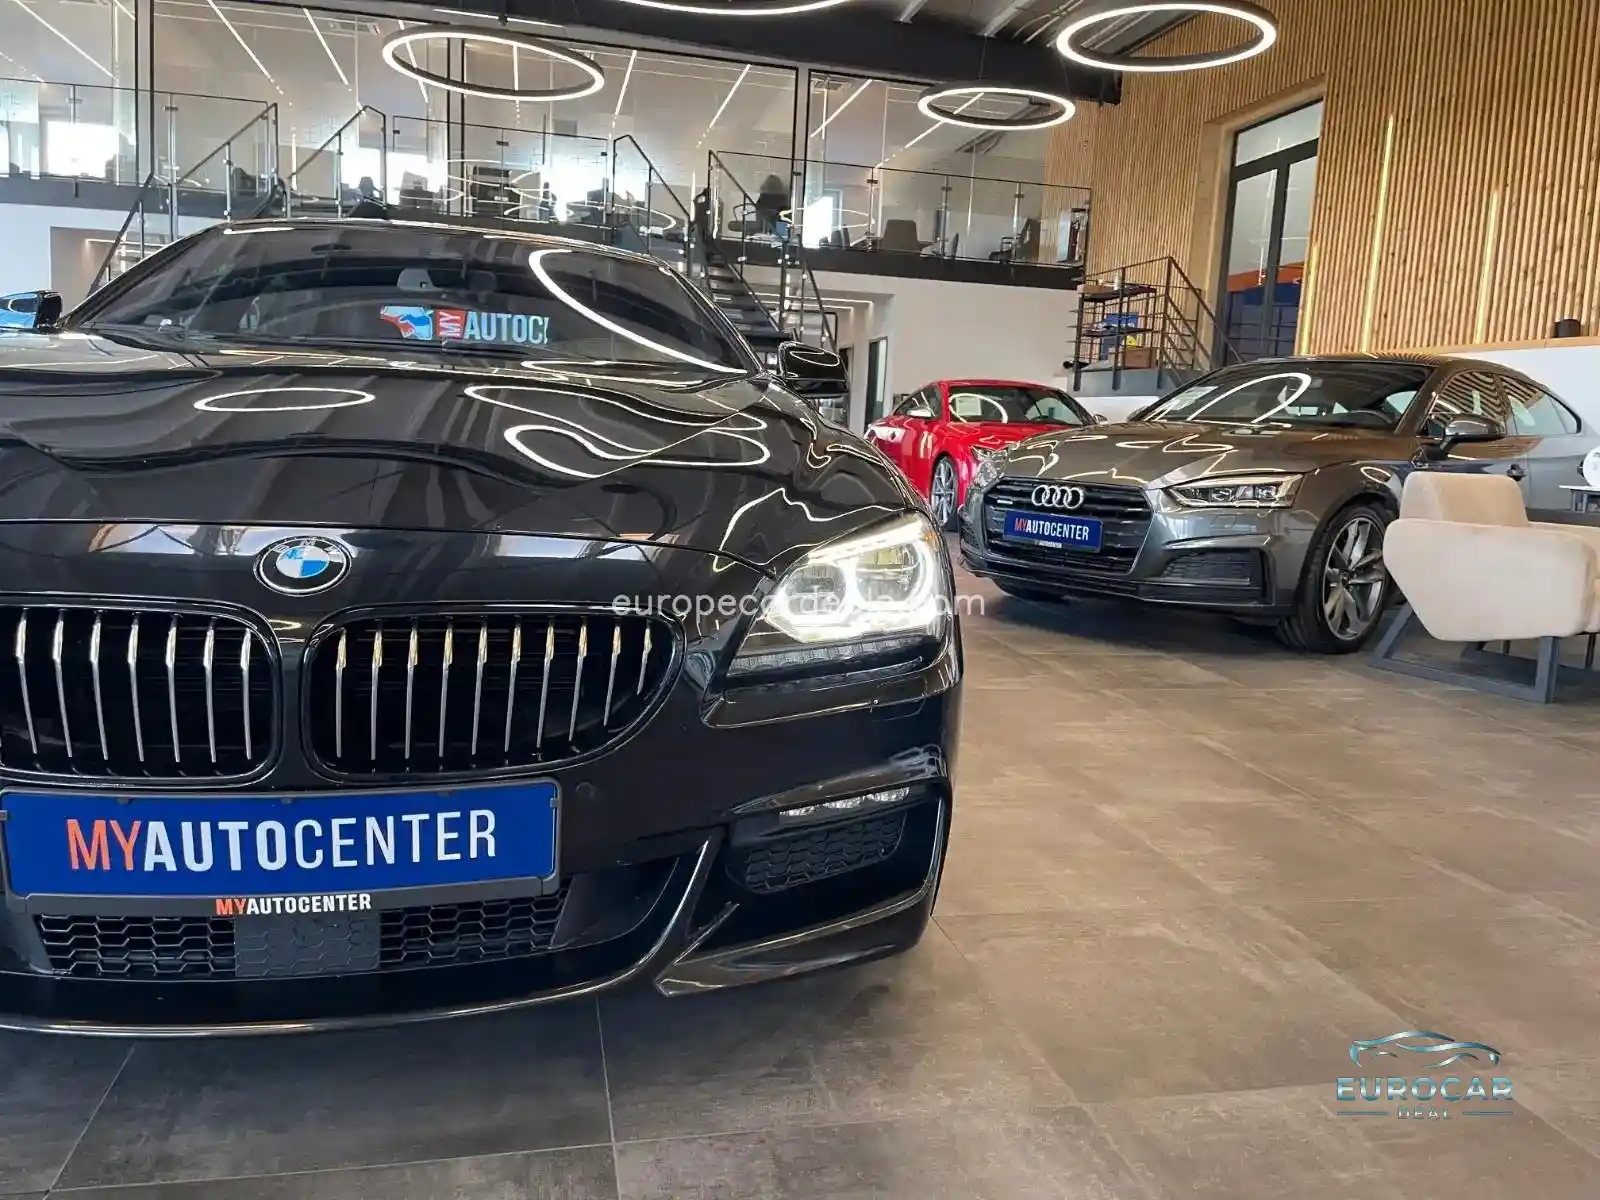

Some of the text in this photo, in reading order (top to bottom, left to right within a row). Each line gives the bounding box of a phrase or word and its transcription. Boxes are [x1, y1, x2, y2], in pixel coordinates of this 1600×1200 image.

[439, 311, 461, 337] MY
[1014, 517, 1090, 541] MYAUTOCENTER
[66, 809, 497, 872] MYAUTOCENTER
[215, 893, 372, 916] MYAUTOCENTER
